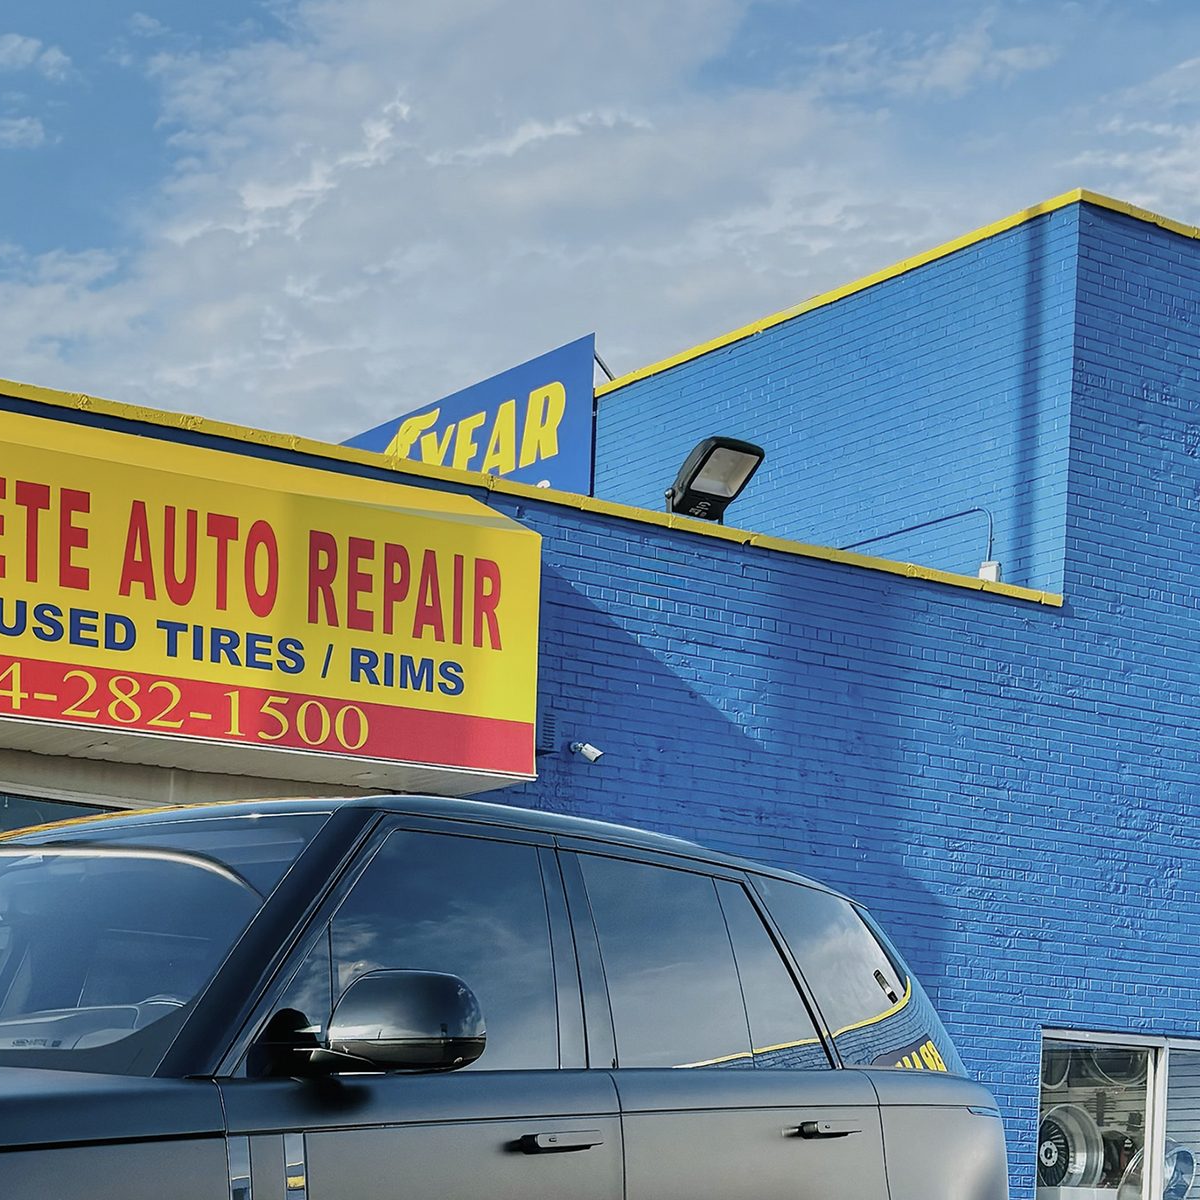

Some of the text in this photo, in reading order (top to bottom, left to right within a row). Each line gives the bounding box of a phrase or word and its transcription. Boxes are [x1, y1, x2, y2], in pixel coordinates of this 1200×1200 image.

[118, 499, 279, 618] AUTO
[307, 529, 502, 651] REPAIR
[156, 619, 305, 675] TIRES
[321, 644, 334, 679] /
[350, 647, 465, 696] RIMS
